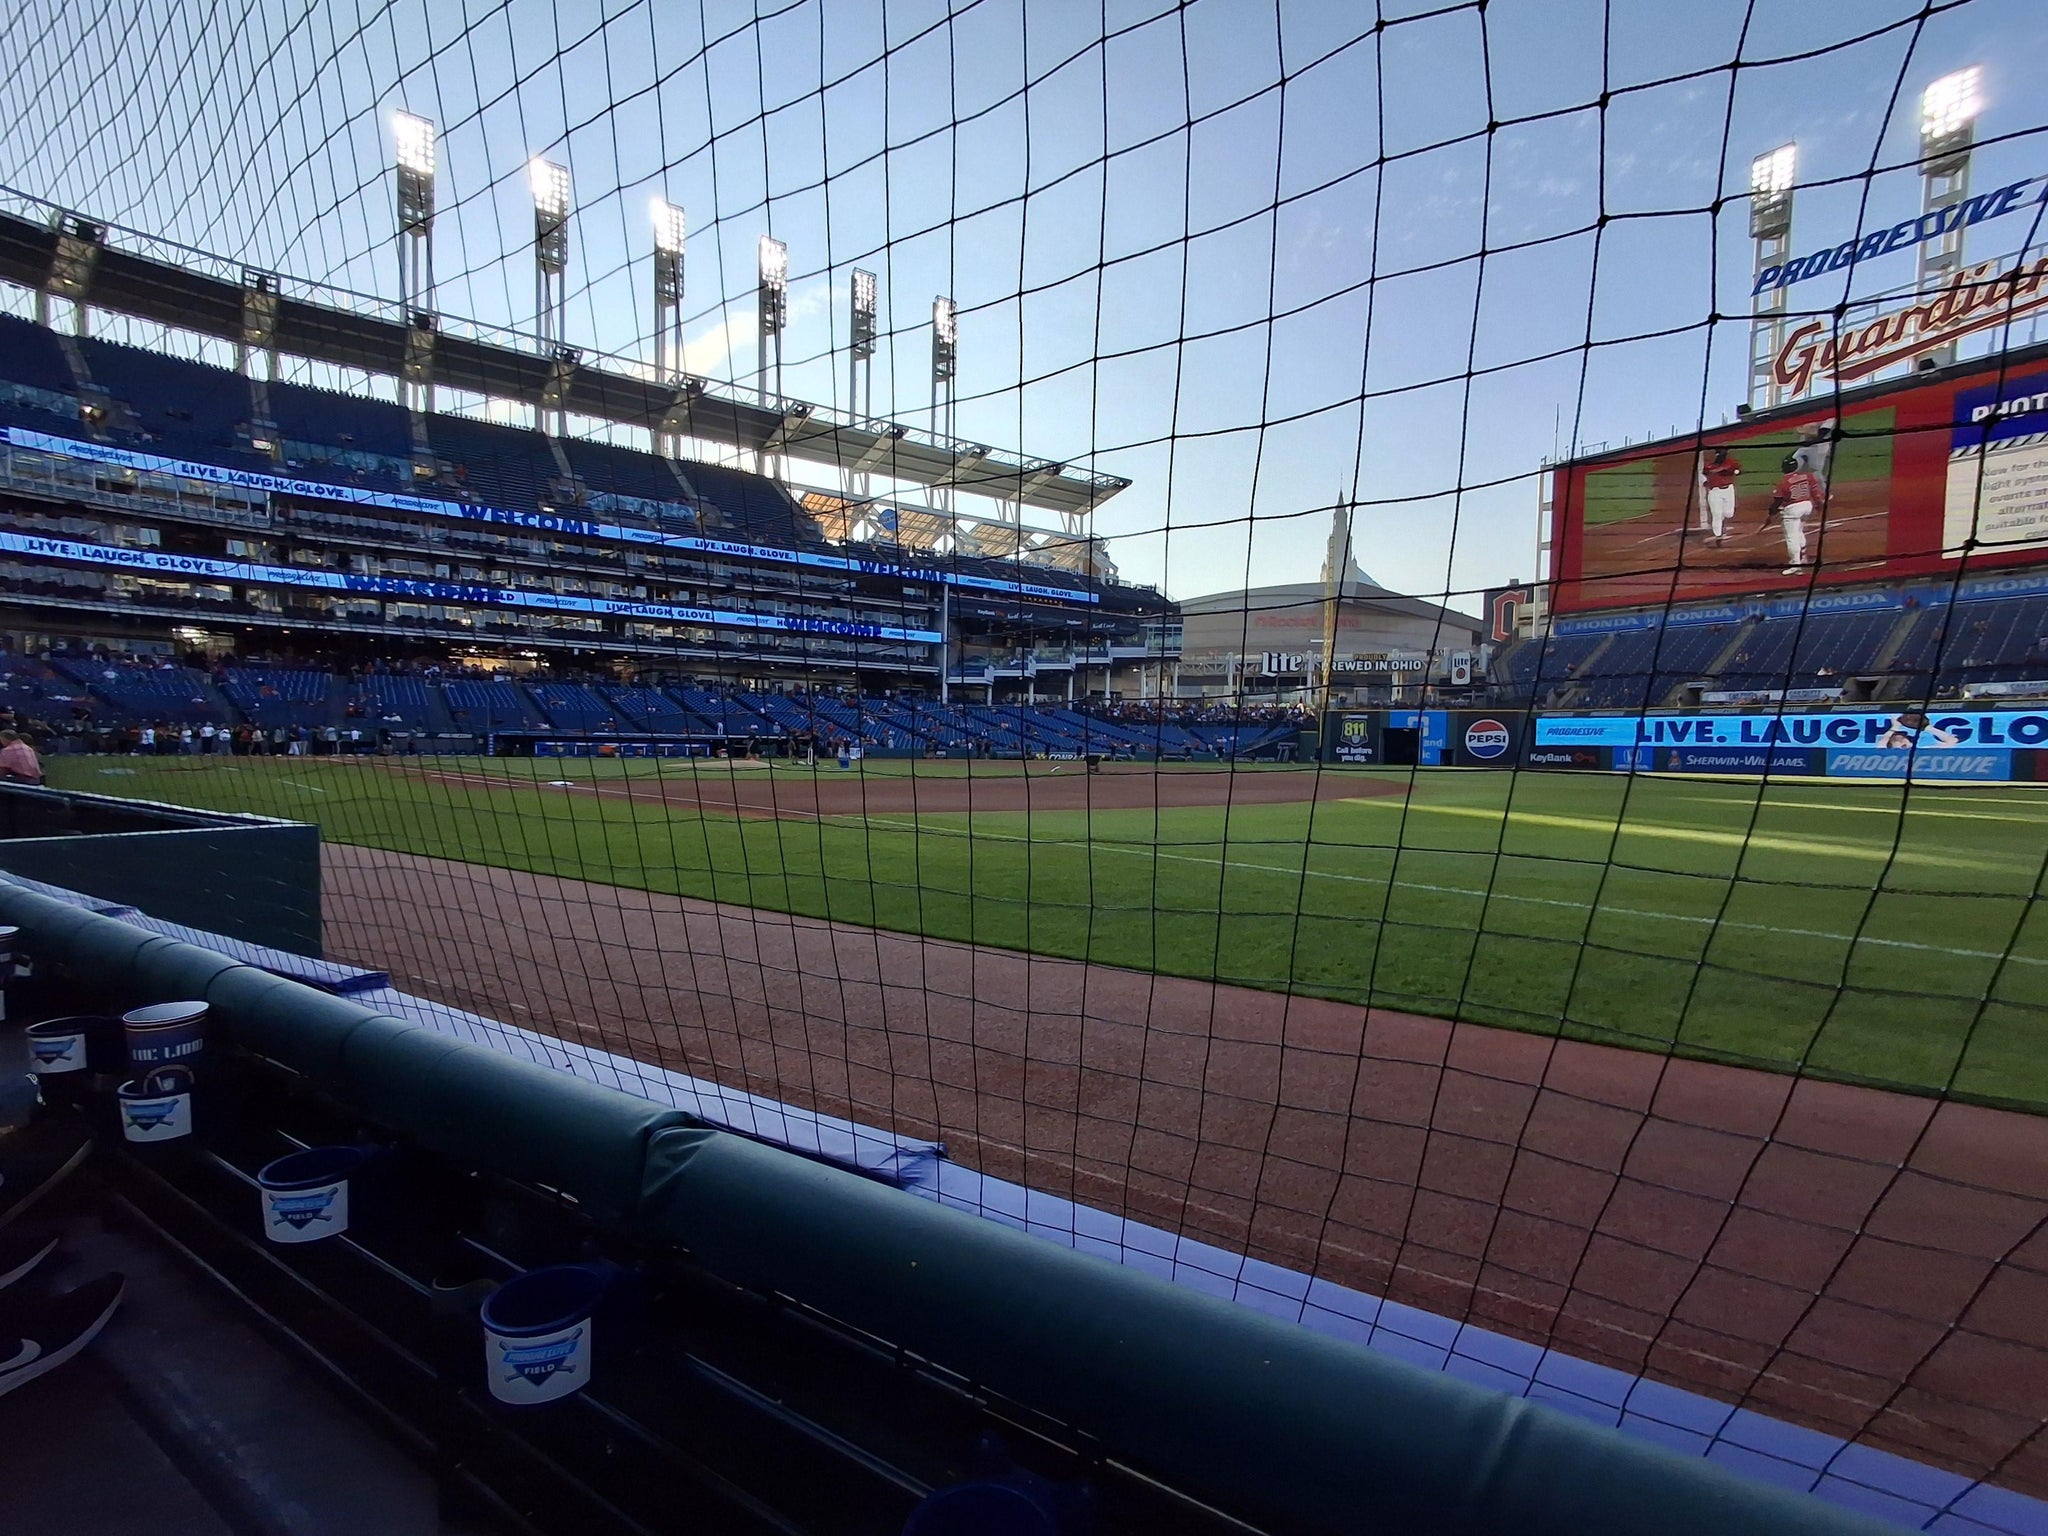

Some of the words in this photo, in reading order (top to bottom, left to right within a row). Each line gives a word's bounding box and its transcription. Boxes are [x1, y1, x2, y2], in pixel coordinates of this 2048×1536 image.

[1751, 178, 2033, 297] PROGRESSIVE
[182, 463, 222, 479] LIVE.
[294, 482, 349, 499] GLOVE.
[458, 503, 600, 536] WELCOME
[695, 540, 719, 551] LIVE.
[721, 543, 757, 556] LAUGH.
[759, 548, 793, 560] GLOVE.
[860, 560, 947, 583] WELCOME
[1025, 585, 1050, 595] LAUGH.
[1051, 588, 1073, 598] GLOVE.
[28, 539, 76, 556] LIVE.
[82, 547, 149, 566] LAUGH.
[156, 556, 218, 573] GLOVE.
[1800, 593, 1888, 610] HONDA
[677, 610, 713, 621] GLOVE.
[1575, 616, 1640, 630] HONDA
[1260, 650, 1303, 677] Lite
[1354, 653, 1388, 661] PROUDLY
[1454, 656, 1469, 668] Lite
[1375, 660, 1388, 671] IN
[1392, 660, 1422, 671] OHIO
[1344, 722, 1365, 736] 811
[1546, 727, 1607, 737] PROGRESSIVE
[1635, 720, 1727, 743] LIVE.
[1468, 734, 1506, 743] PEPSI
[1530, 753, 1572, 763] KeyBank
[1830, 754, 1997, 774] PROGRESSIVE
[524, 1363, 555, 1375] FIELD
